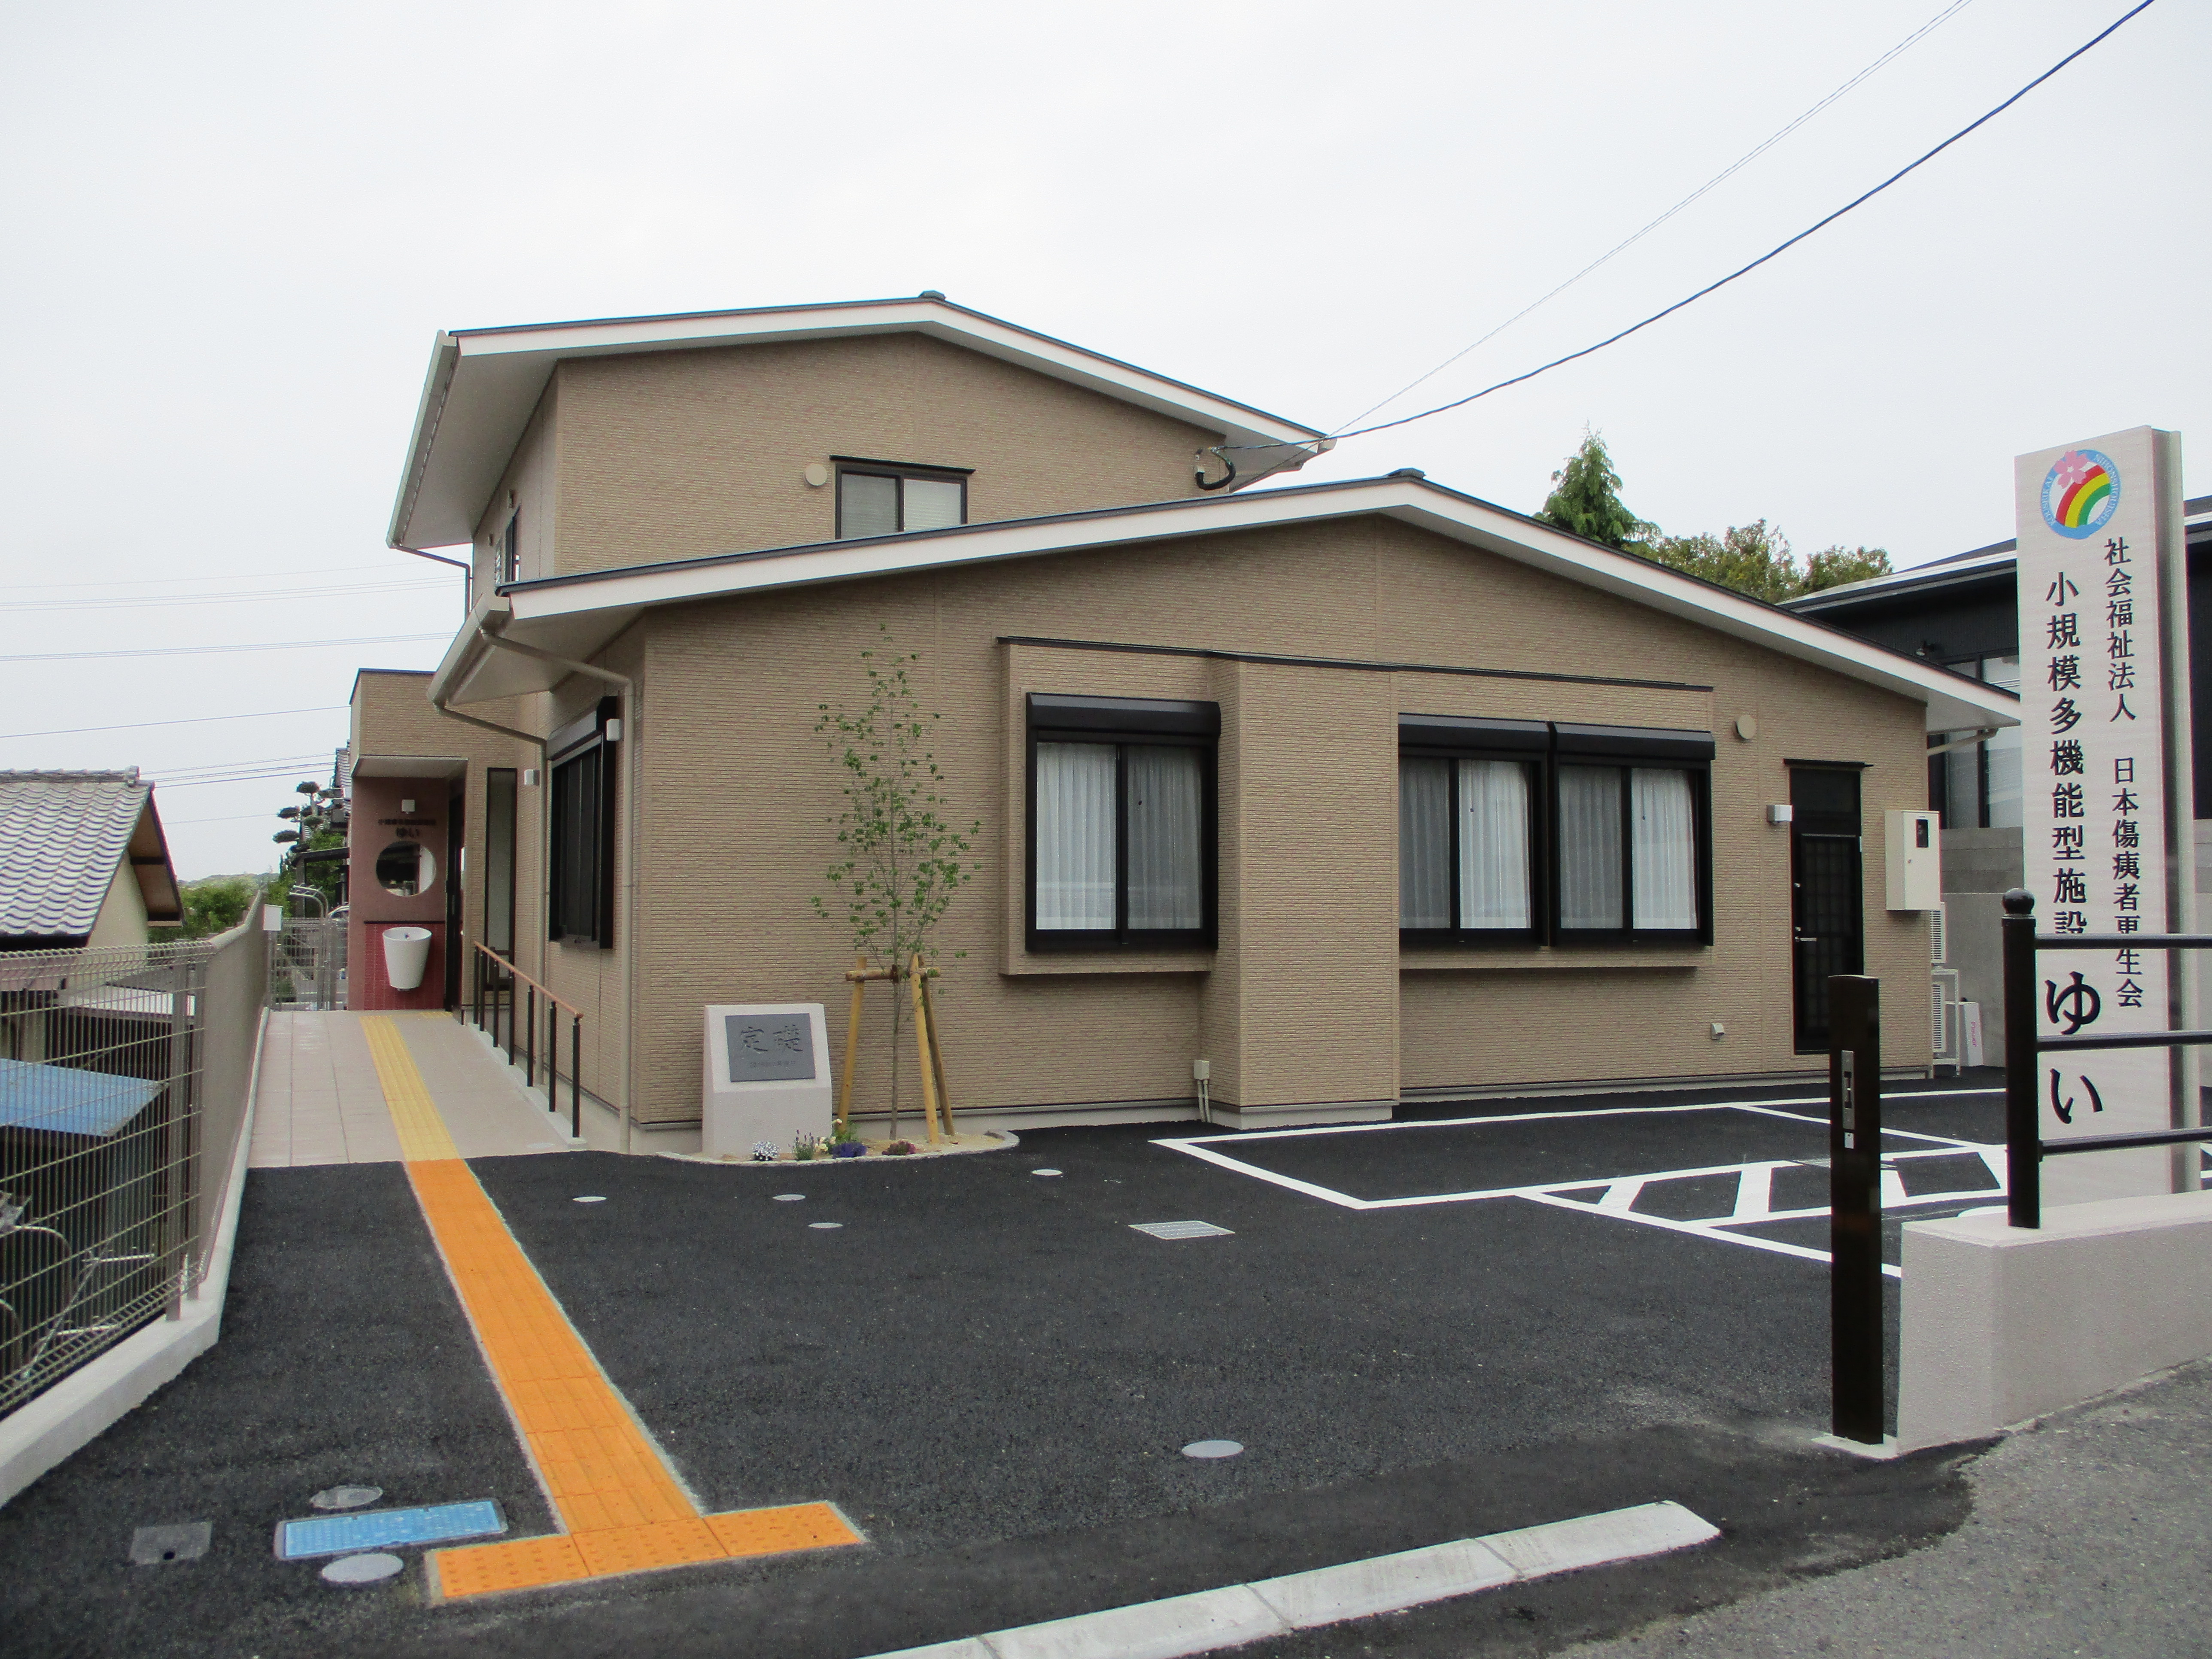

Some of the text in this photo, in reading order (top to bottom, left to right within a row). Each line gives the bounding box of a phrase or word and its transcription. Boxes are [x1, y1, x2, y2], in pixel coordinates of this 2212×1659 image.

[2045, 571, 2087, 933] 小規模多機能型施設
[2103, 536, 2144, 1008] 社会福祉法人 日本傷痍者更生会
[741, 1024, 803, 1052] 定礎
[2044, 971, 2103, 1124] ゆい
